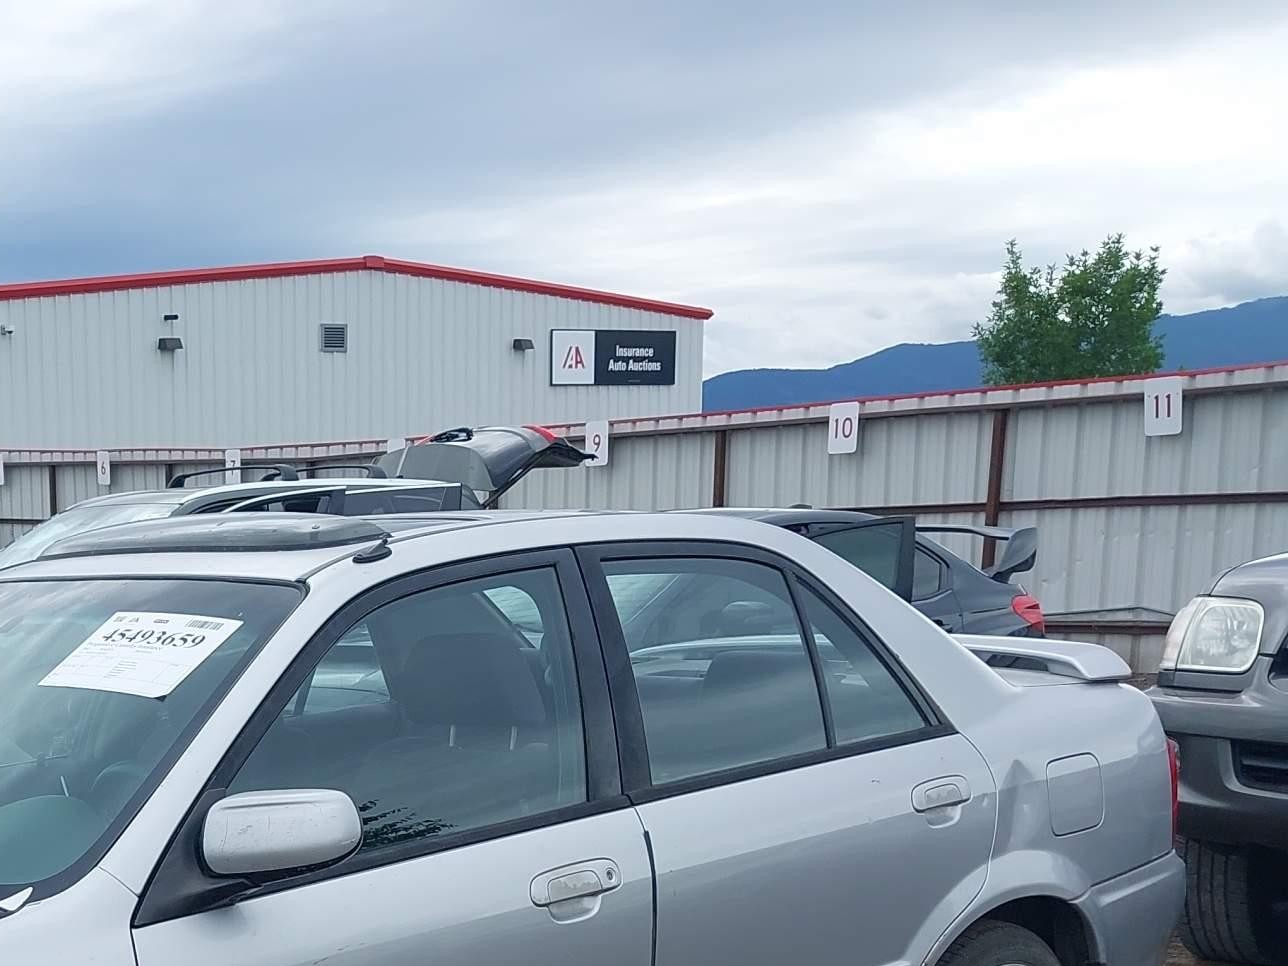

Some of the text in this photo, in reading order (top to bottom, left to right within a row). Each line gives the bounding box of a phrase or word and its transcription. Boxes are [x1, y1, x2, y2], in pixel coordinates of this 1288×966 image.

[615, 345, 654, 357] Insurance
[608, 359, 661, 372] Auto Auctions
[1154, 393, 1171, 419] 11
[834, 417, 853, 439] 10
[592, 434, 601, 452] 9
[100, 461, 107, 476] 6
[230, 460, 236, 476] 7
[102, 628, 206, 649] 45493659
